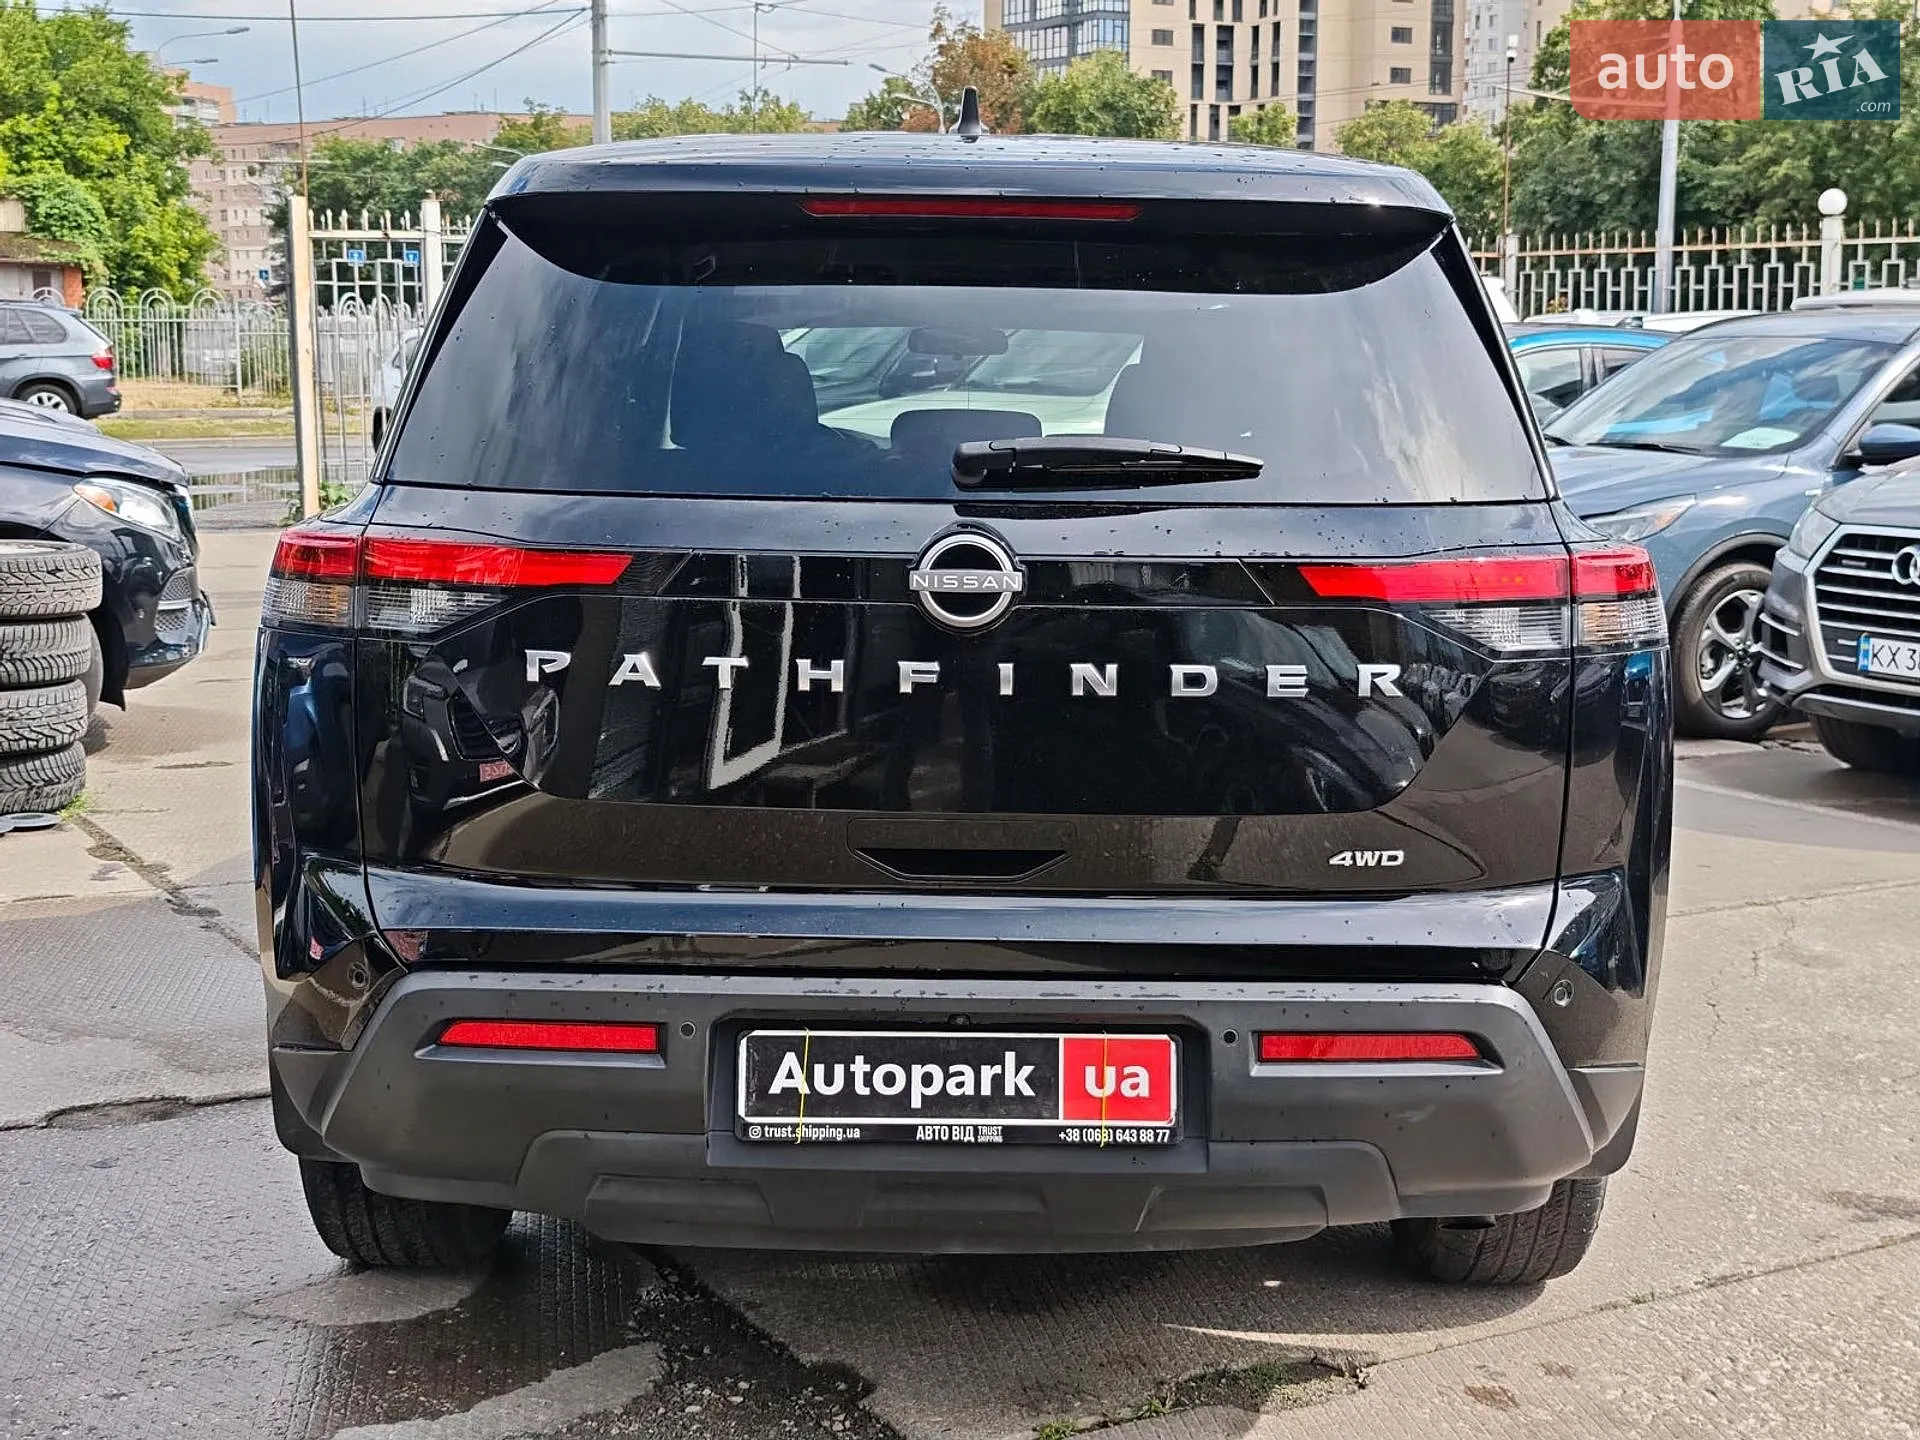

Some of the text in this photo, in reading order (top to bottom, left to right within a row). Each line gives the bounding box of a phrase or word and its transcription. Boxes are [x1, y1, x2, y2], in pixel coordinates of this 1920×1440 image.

[913, 574, 1020, 589] NISSAN
[1906, 647, 1920, 671] 3
[525, 649, 1403, 698] PATHFINDER
[1328, 849, 1404, 867] 4WD
[768, 1051, 1151, 1109] Autopark ua
[764, 1124, 861, 1141] trust.shipping.ua
[916, 1125, 975, 1143] АВТО ВІД
[977, 1125, 1003, 1135] TRUST
[1058, 1128, 1080, 1143] +38
[1116, 1129, 1138, 1143] 643
[1140, 1129, 1155, 1143] 88
[1156, 1129, 1171, 1144] 77
